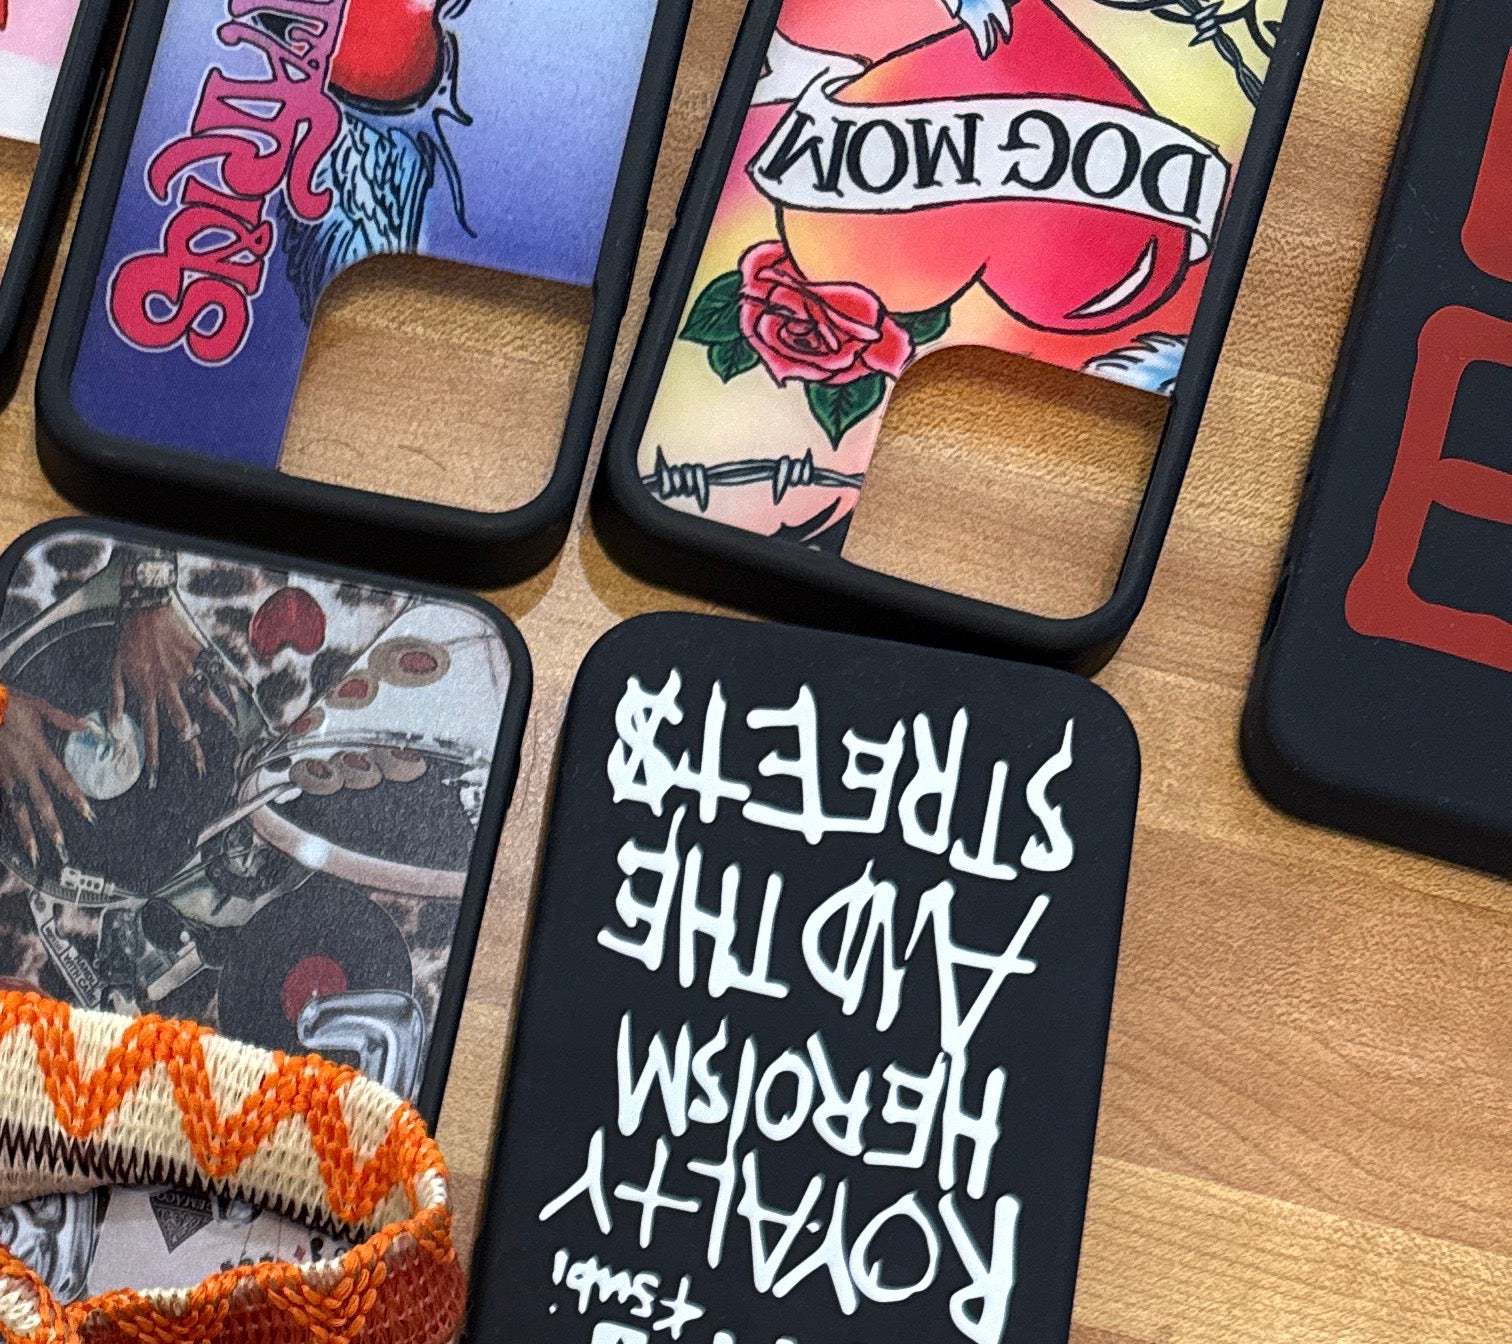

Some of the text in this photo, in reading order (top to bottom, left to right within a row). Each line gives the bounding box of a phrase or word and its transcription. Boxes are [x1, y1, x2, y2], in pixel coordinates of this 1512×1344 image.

[758, 109, 1213, 225] DOG MOM
[597, 804, 1052, 1054] AND THE
[616, 1010, 1006, 1200] HEROISM
